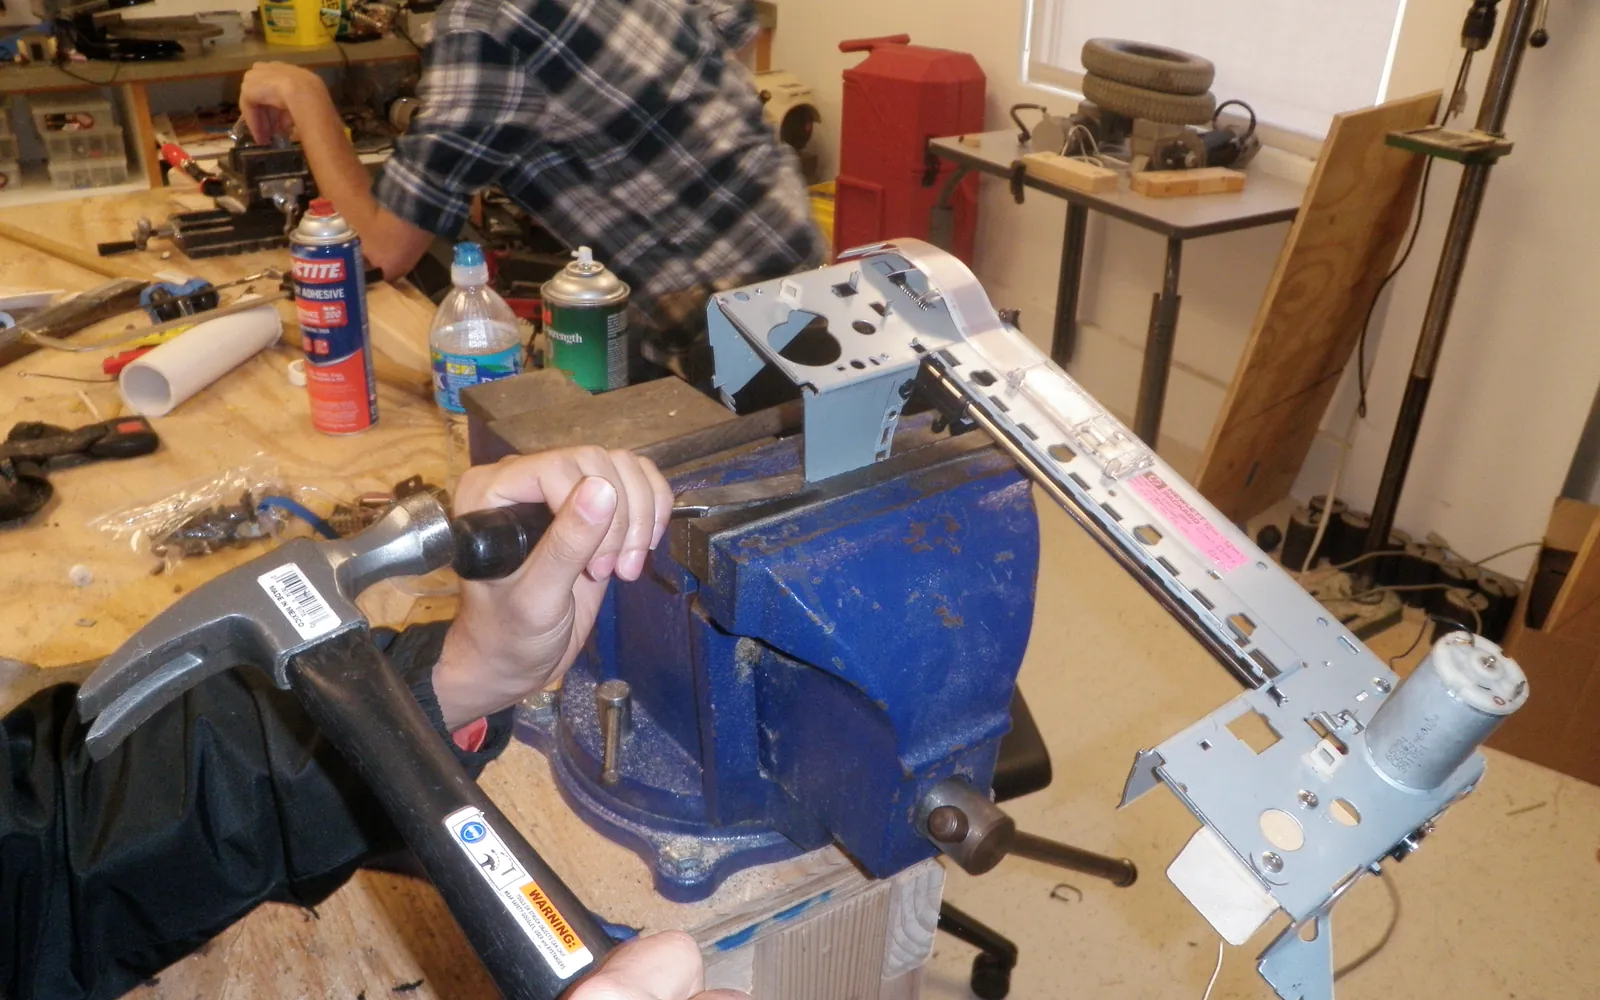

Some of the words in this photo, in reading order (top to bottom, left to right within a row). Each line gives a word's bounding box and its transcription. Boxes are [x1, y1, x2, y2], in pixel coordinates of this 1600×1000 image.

[301, 287, 345, 300] ADHESIVE
[1162, 491, 1200, 524] PACKARD
[1168, 488, 1208, 521] HEWLETT
[269, 585, 283, 602] MADE
[286, 606, 305, 628] MEXICO
[528, 888, 576, 948] WARNING:
